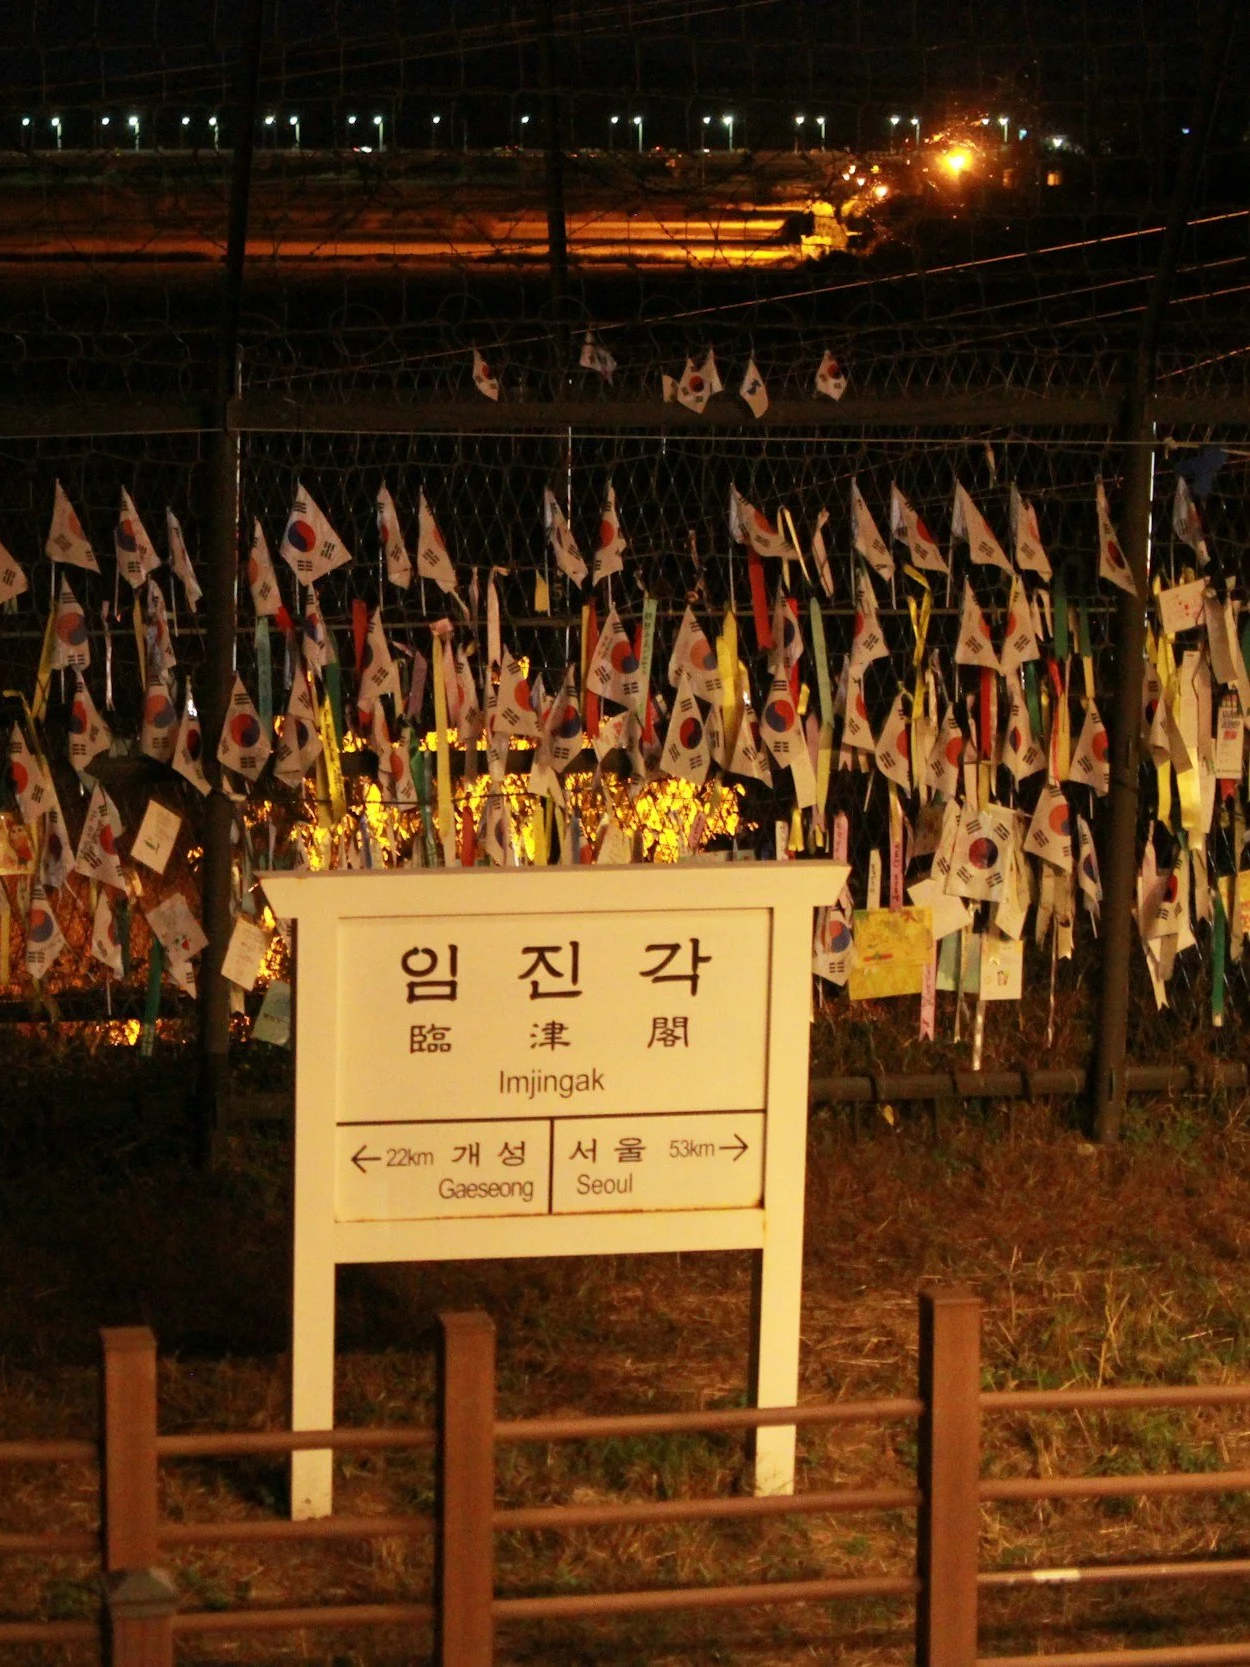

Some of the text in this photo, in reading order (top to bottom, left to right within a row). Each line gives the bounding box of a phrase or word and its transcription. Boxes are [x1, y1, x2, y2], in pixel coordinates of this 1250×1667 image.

[400, 937, 712, 1005] 임진각
[499, 1067, 605, 1100] Imjingak
[386, 1140, 526, 1167] 22km 개성
[569, 1137, 715, 1163] 서울 53km
[438, 1178, 534, 1203] Gaeseong
[576, 1173, 633, 1195] Seoul
